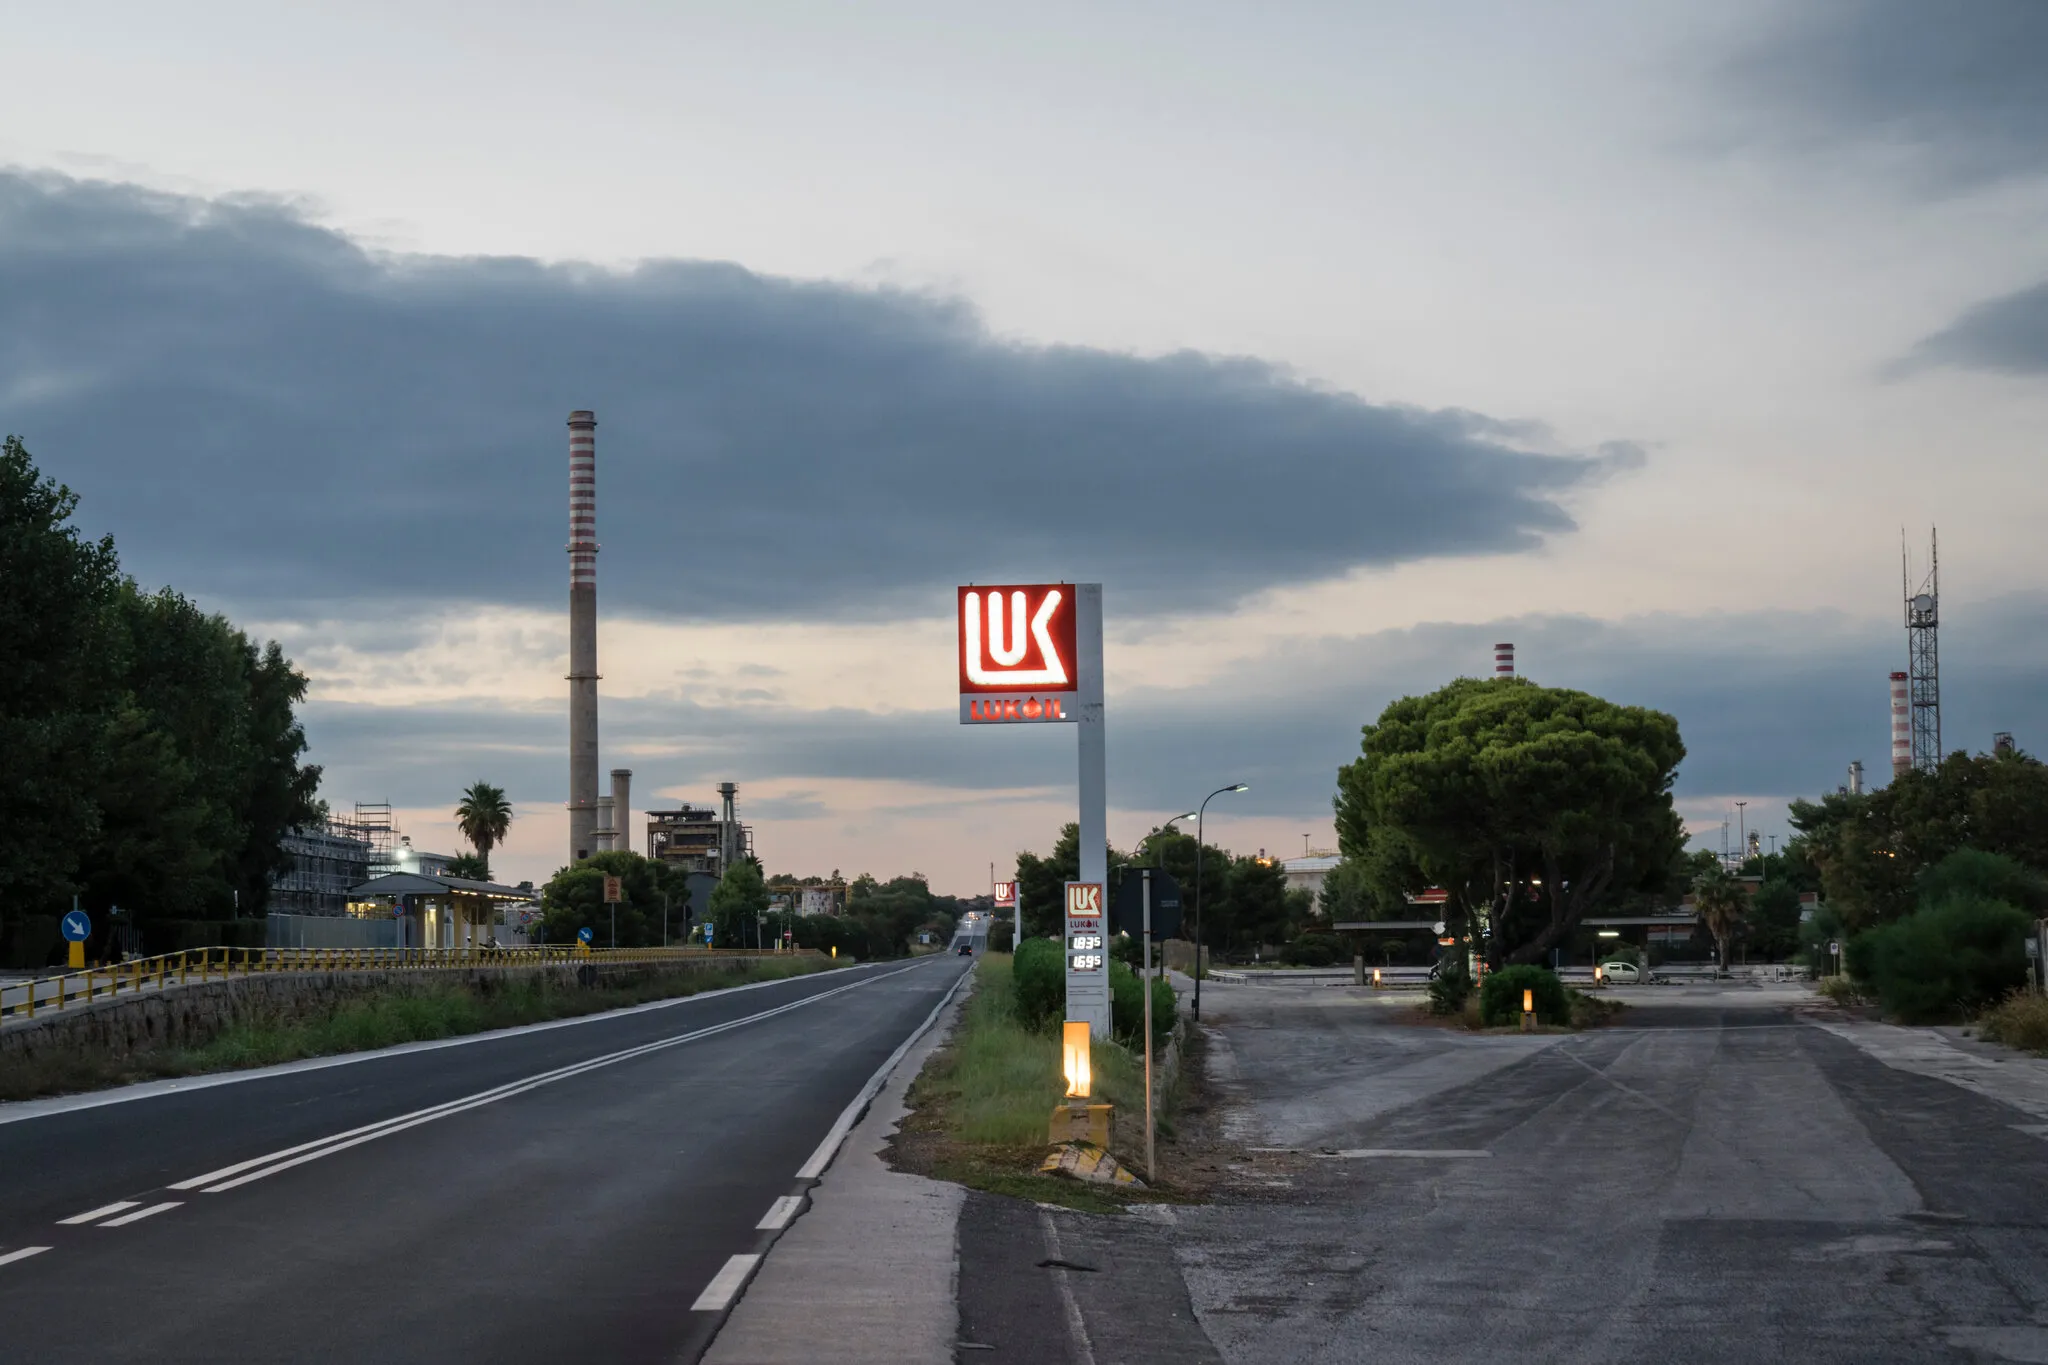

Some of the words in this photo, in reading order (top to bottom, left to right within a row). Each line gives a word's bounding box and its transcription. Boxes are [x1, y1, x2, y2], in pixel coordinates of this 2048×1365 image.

[965, 590, 1068, 685] LUK
[971, 696, 1065, 720] LUKOIL
[1069, 887, 1101, 915] LUK
[1070, 920, 1099, 928] LUKOIL
